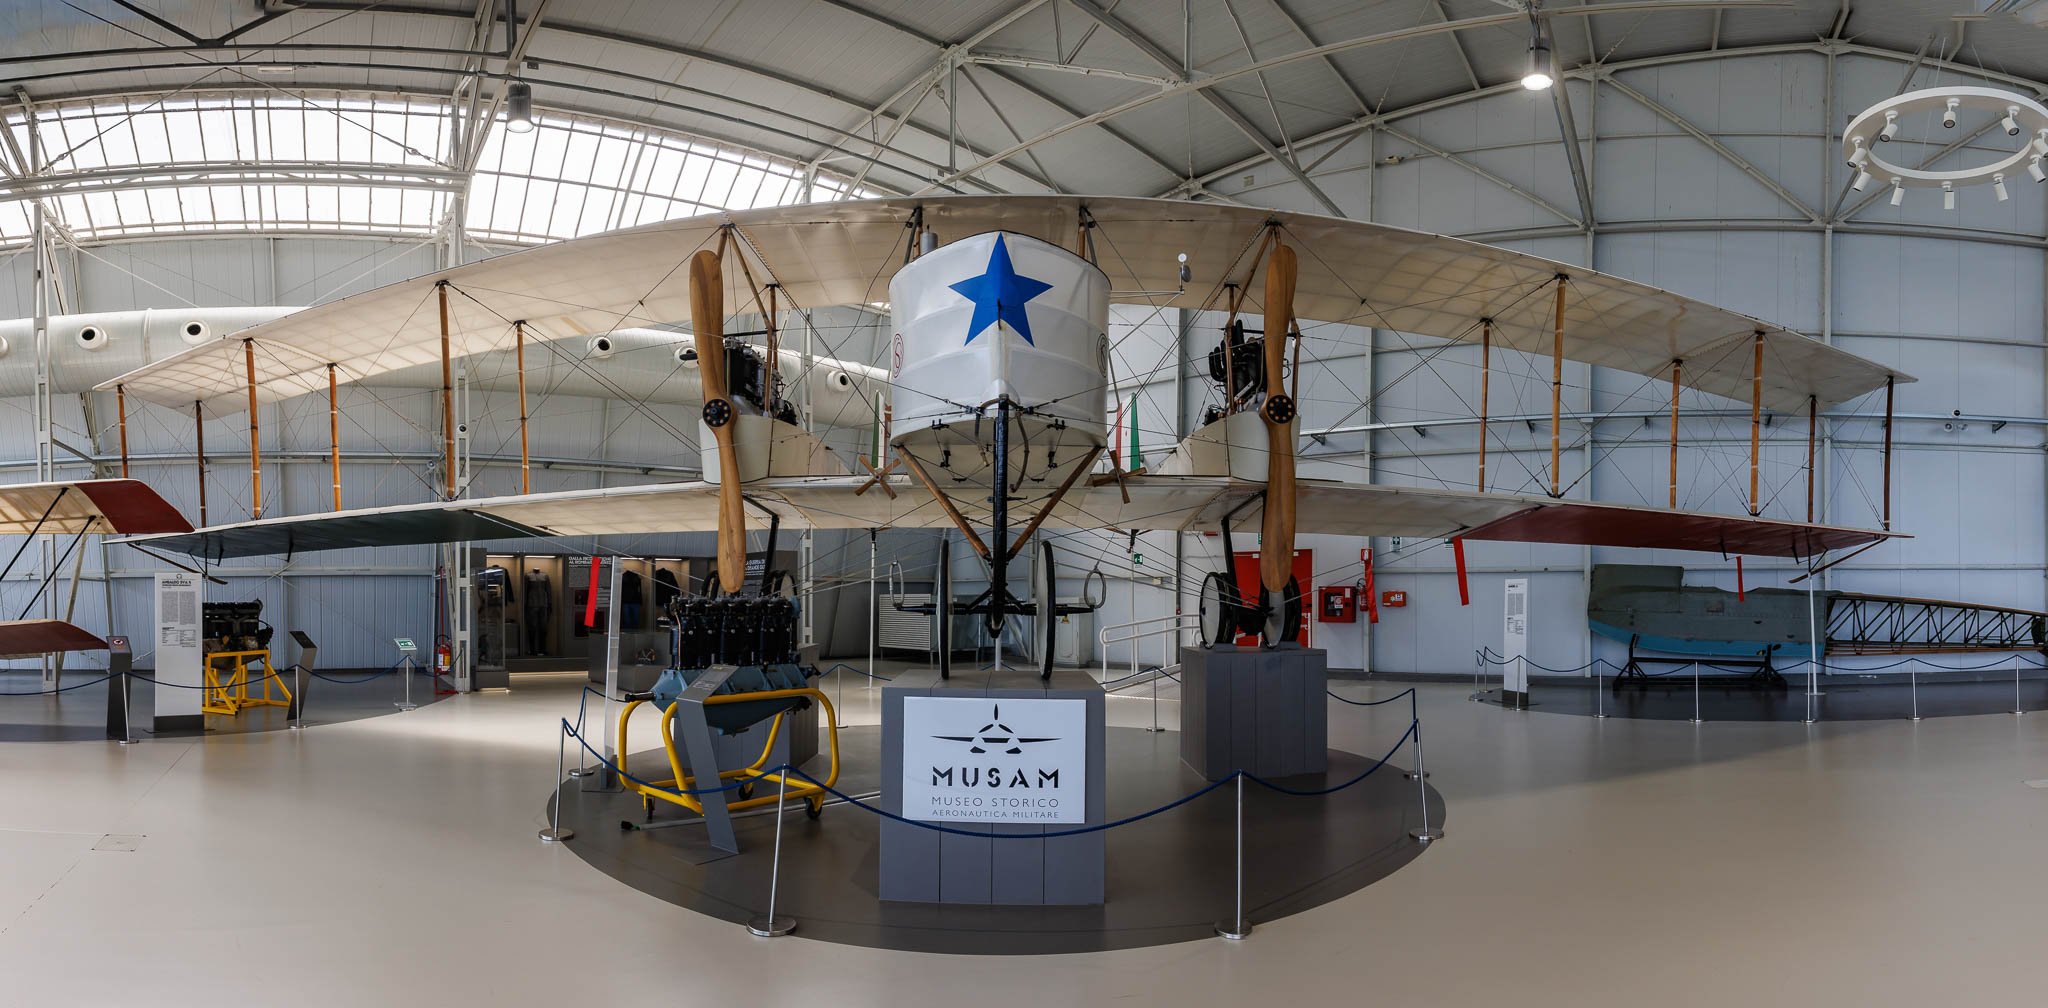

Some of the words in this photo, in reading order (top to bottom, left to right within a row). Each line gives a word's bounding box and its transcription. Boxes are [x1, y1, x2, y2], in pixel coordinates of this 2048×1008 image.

[932, 766, 1059, 788] MUSAM
[932, 796, 983, 807] MUSEO
[992, 798, 1059, 808] STORICO
[932, 809, 1008, 818] AERONAUTICA
